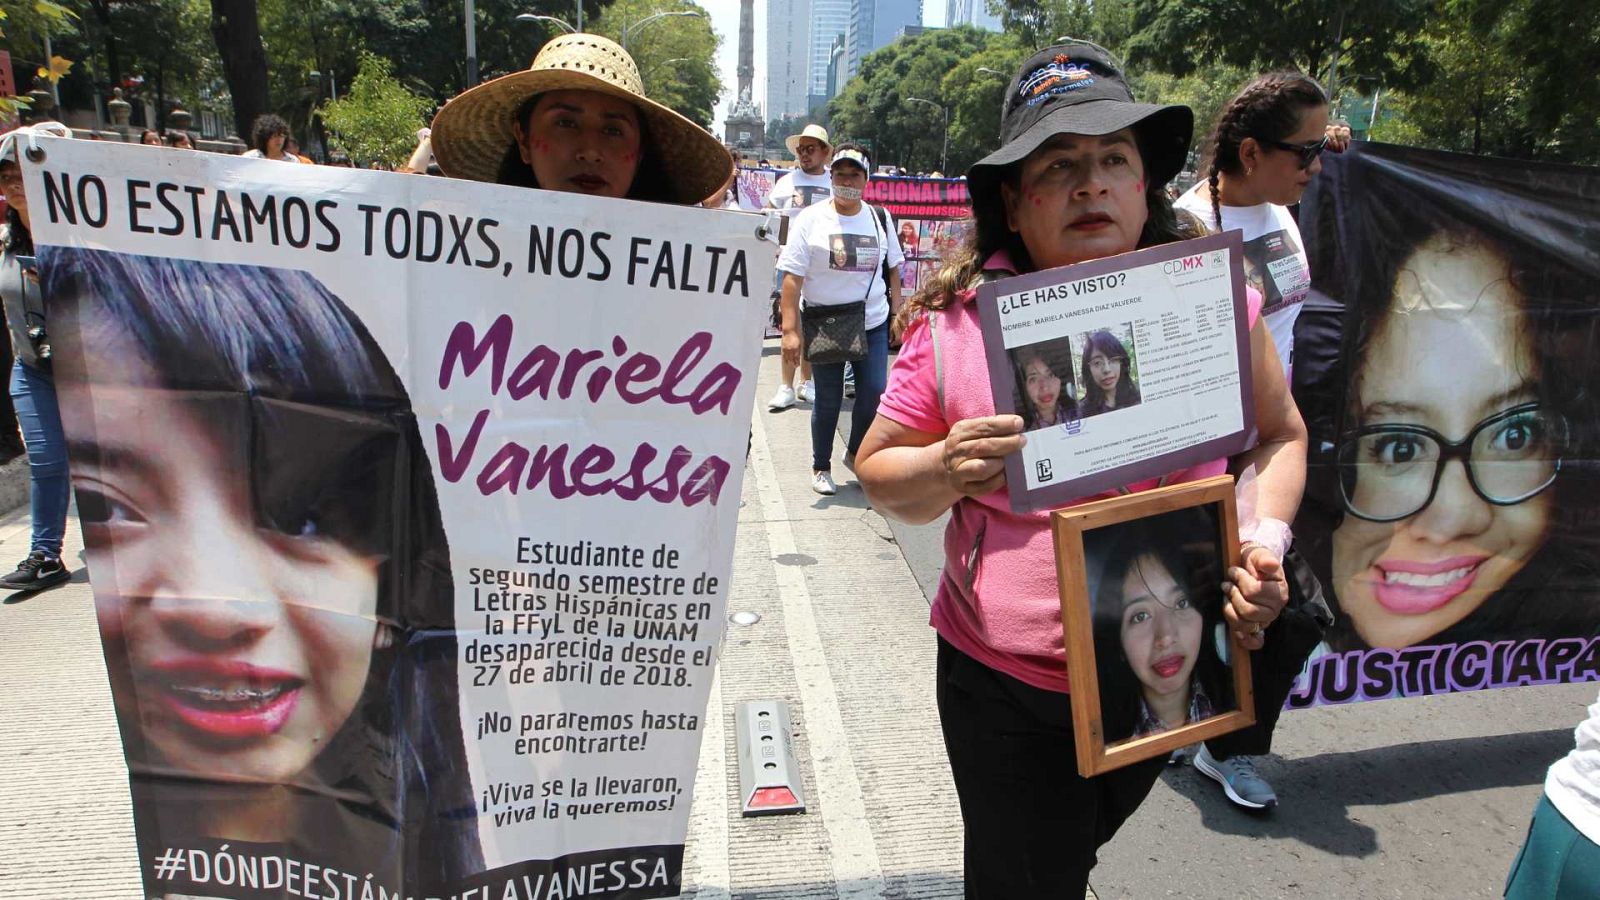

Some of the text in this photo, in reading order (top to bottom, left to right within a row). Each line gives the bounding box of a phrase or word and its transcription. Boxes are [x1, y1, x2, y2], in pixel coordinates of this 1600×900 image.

[863, 180, 941, 203] ACIONAL
[42, 170, 749, 298] NO ESTAMOS TODXS, NOS FALTA
[1163, 255, 1204, 275] CDMX
[1001, 272, 1127, 315] ¿LE HAS VISTO?
[1034, 313, 1064, 326] MARIELA
[1064, 307, 1095, 319] VANESSA
[1095, 304, 1110, 314] DIAZ
[1111, 296, 1143, 309] VALVERDE
[438, 313, 742, 415] Mariela
[435, 409, 731, 507] Vanessa
[517, 537, 679, 569] Estudiante de
[469, 567, 719, 596] segundo semestre de
[474, 587, 711, 620] Letras Hispánicas en
[485, 613, 699, 642] la FFyL de la UNAM
[465, 637, 713, 667] desaparecida desde el
[473, 660, 693, 687] 27 de abril de 2018.
[1288, 639, 1600, 708] JUSTICIAPA
[477, 710, 698, 740] ¡No pararemos hasta
[515, 731, 648, 755] encontrarte!
[482, 776, 683, 812] ¡Viva se la llevaron,
[494, 795, 676, 828] viva la queremos!
[154, 844, 668, 900] #DÓNDEESTÁAVANESSA
